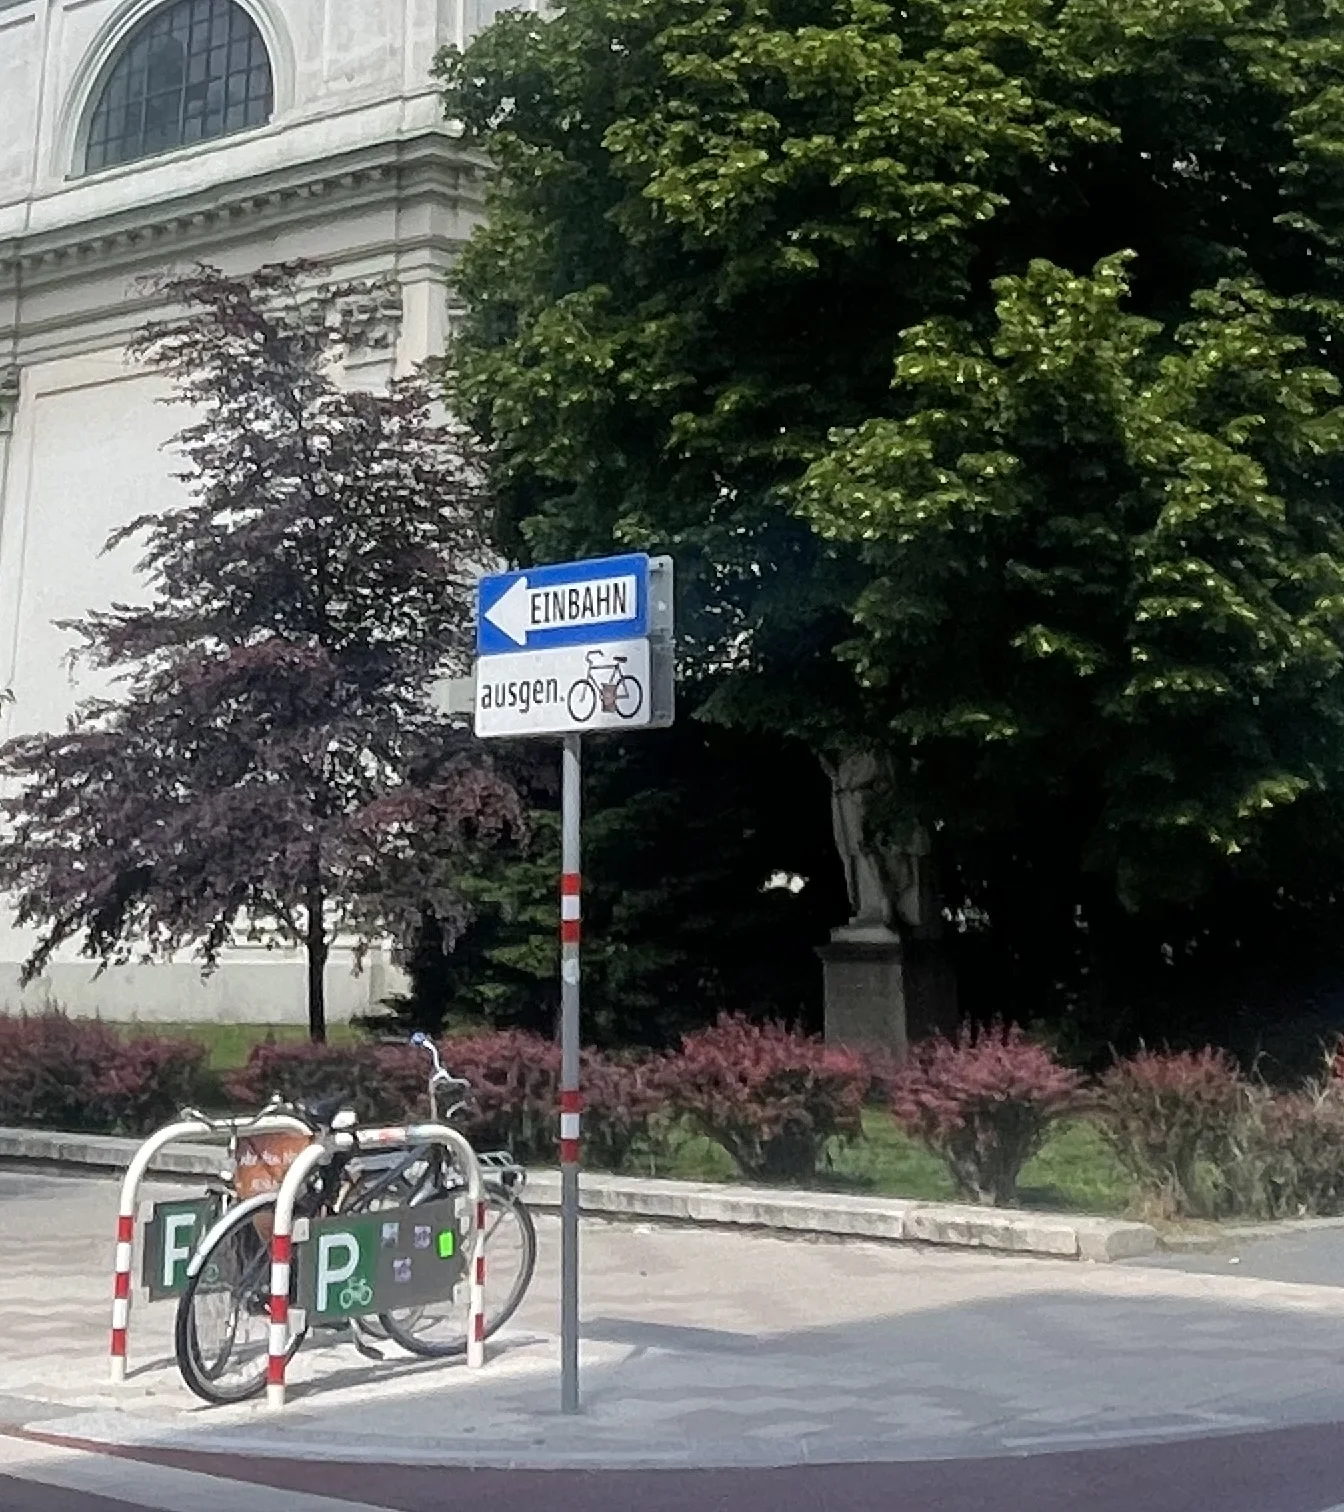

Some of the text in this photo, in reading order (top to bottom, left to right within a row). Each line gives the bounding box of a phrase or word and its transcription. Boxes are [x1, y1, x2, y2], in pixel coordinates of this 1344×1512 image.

[531, 581, 626, 624] EINBAHN
[481, 678, 565, 713] ausgen.
[317, 1233, 360, 1311] P
